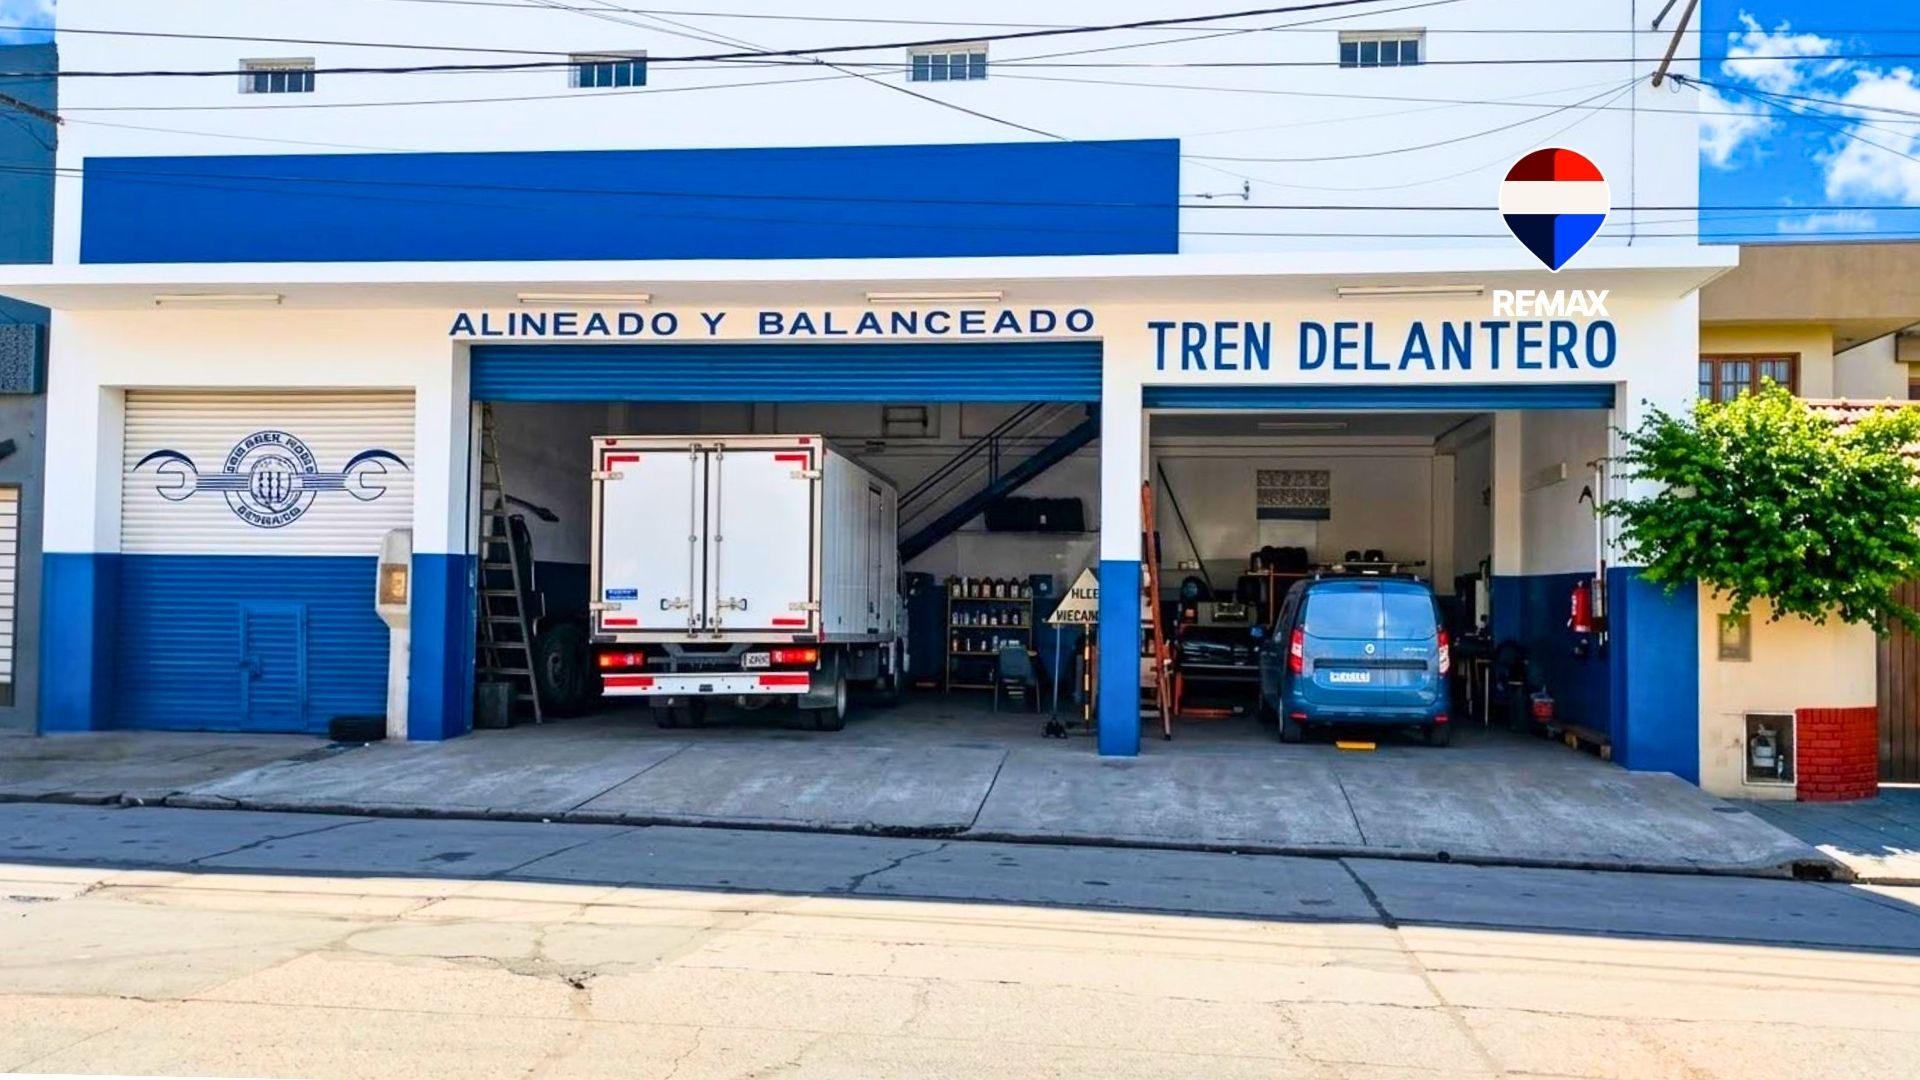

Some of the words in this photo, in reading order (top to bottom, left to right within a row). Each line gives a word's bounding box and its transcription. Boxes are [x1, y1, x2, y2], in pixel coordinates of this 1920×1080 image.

[449, 311, 678, 336] ALINEADO
[700, 311, 727, 336] Y
[758, 308, 1095, 336] BALANCEADO
[1147, 321, 1271, 371] TREN
[1299, 319, 1617, 371] DELANTERO
